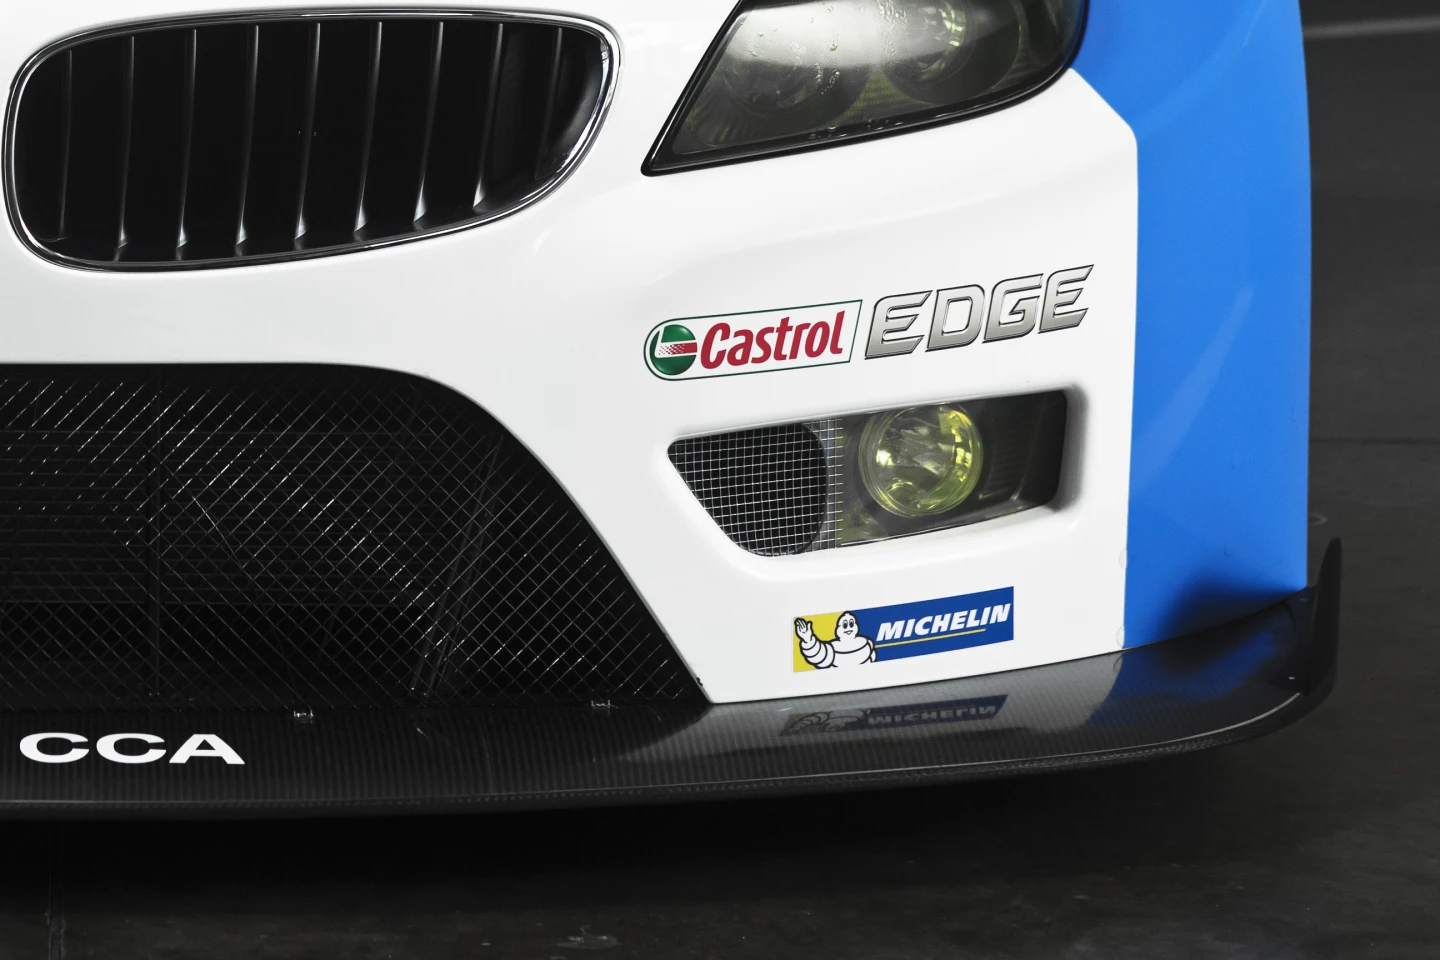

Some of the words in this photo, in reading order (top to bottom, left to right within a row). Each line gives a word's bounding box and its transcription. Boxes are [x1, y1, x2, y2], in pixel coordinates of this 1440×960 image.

[700, 310, 846, 370] Castrol
[864, 263, 1095, 360] EDGE
[876, 602, 1012, 643] MICHELIN
[19, 732, 246, 765] CCA
